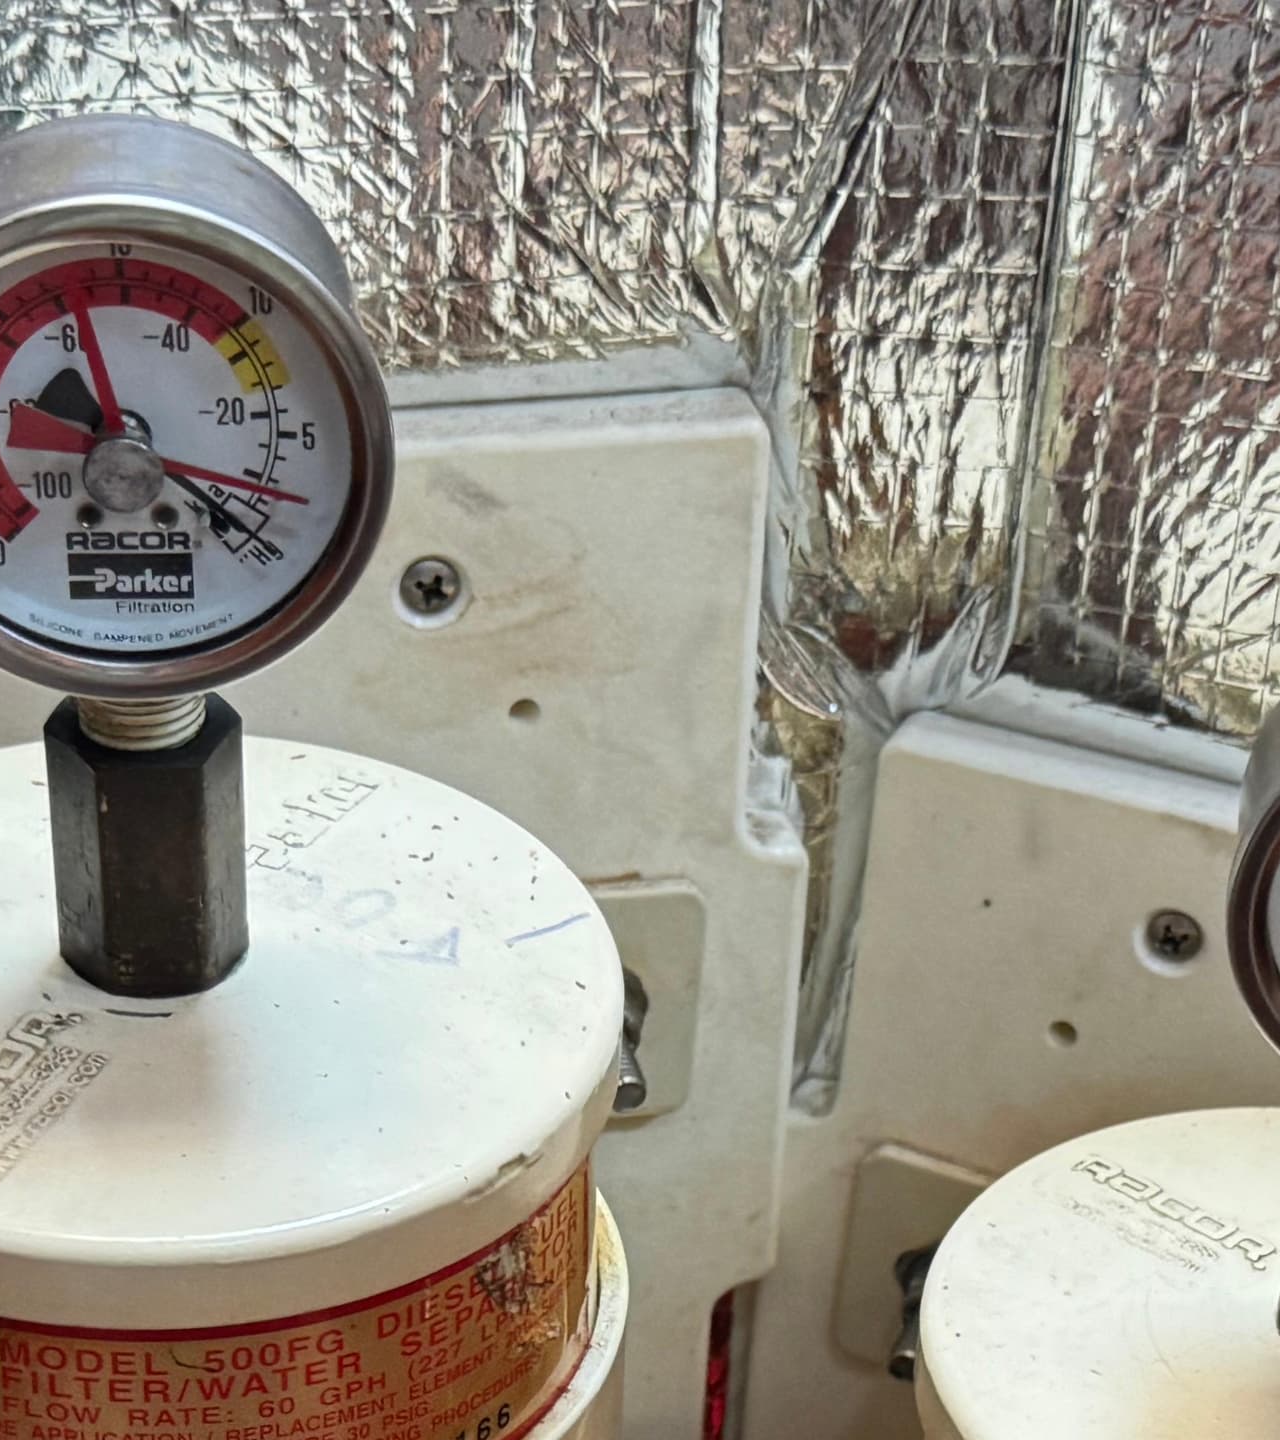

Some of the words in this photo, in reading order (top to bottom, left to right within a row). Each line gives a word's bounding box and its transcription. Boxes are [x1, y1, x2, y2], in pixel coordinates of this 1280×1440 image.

[249, 287, 272, 315] 10
[302, 423, 316, 450] 5
[94, 568, 193, 593] Parker
[115, 601, 195, 614] Filtration
[203, 1329, 345, 1374] 500FG
[1, 1351, 362, 1404] FILTER/WATER
[3, 1395, 101, 1425] FLOW
[128, 1407, 234, 1427] RATE:
[258, 1397, 296, 1419] 60
[320, 1372, 387, 1406] GPH
[407, 1338, 464, 1382] (227
